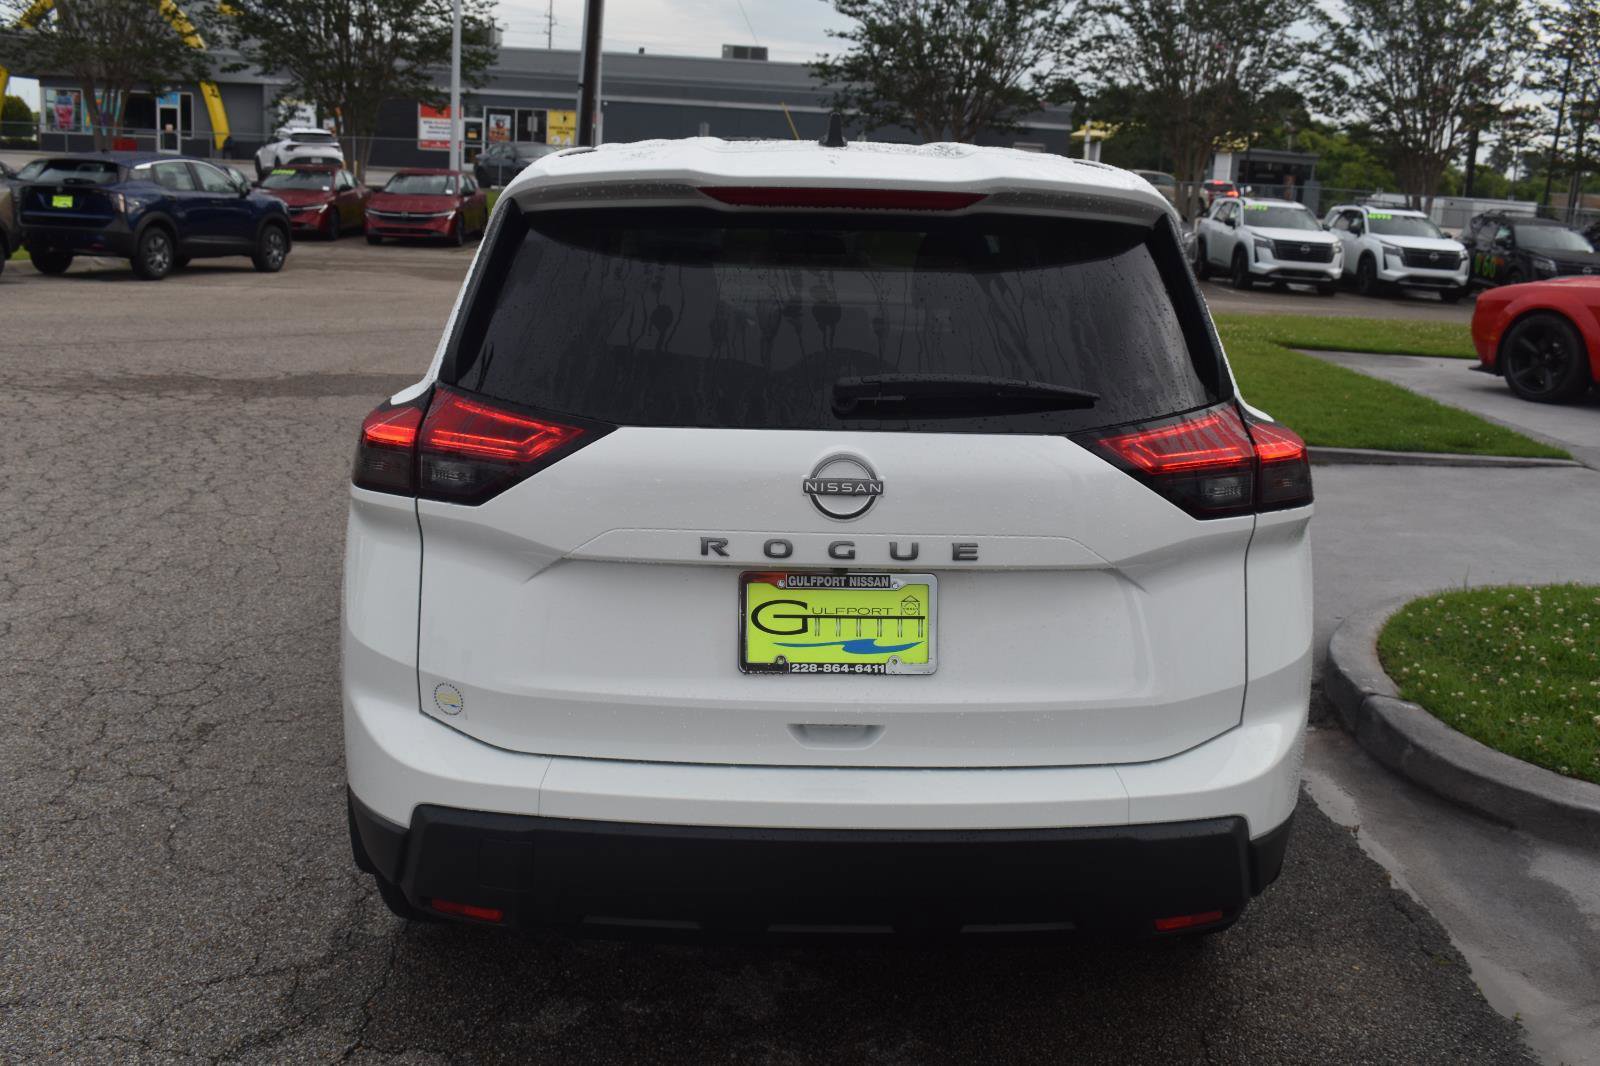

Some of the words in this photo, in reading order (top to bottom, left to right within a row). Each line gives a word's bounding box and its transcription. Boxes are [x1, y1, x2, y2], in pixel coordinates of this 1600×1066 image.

[805, 480, 882, 494] NISSAN
[700, 536, 979, 561] ROGUE
[788, 575, 847, 587] GULFPORT
[849, 576, 890, 588] NISSAN
[751, 599, 895, 636] GULFPORT
[791, 664, 885, 673] 228-864-6411
